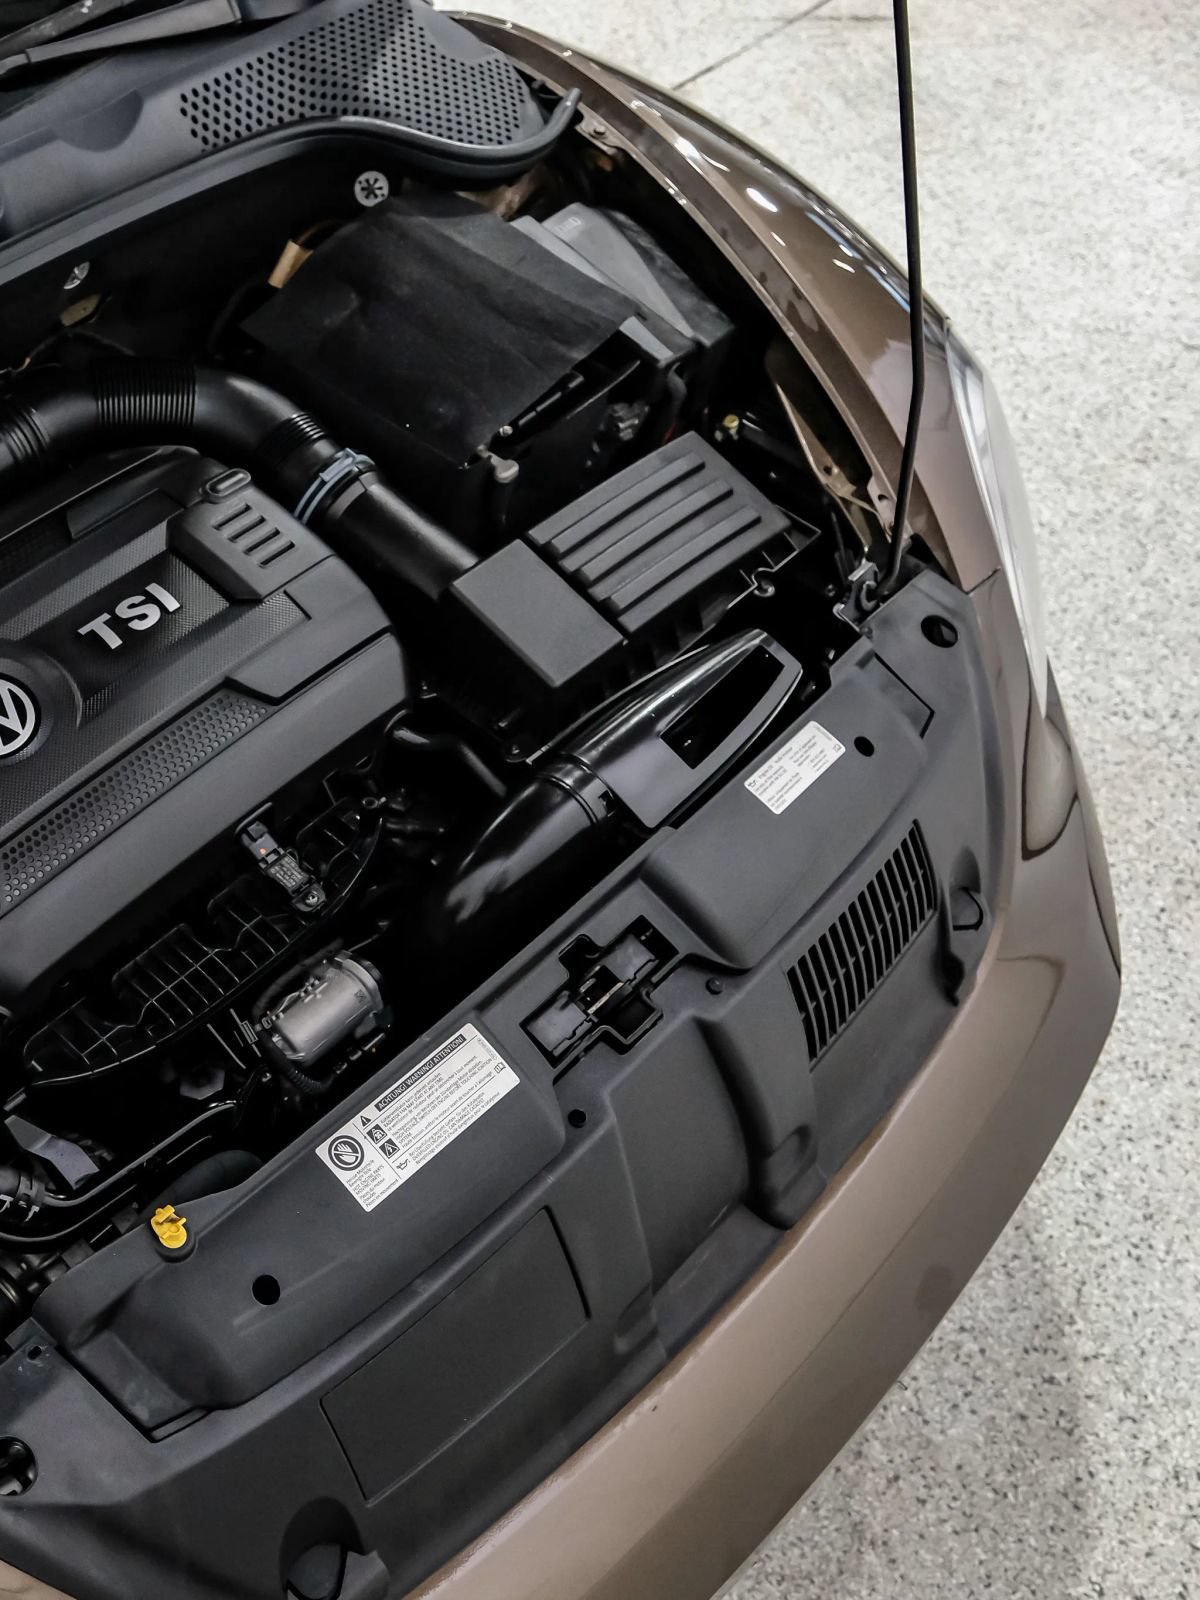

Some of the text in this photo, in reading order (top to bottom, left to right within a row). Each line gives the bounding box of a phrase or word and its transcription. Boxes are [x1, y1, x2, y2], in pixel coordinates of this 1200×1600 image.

[77, 582, 182, 651] TSI
[378, 1083, 407, 1108] ACHTUNG!
[405, 1060, 435, 1086] WARNING!
[433, 1036, 464, 1063] ATTENTION!
[413, 1092, 424, 1102] START
